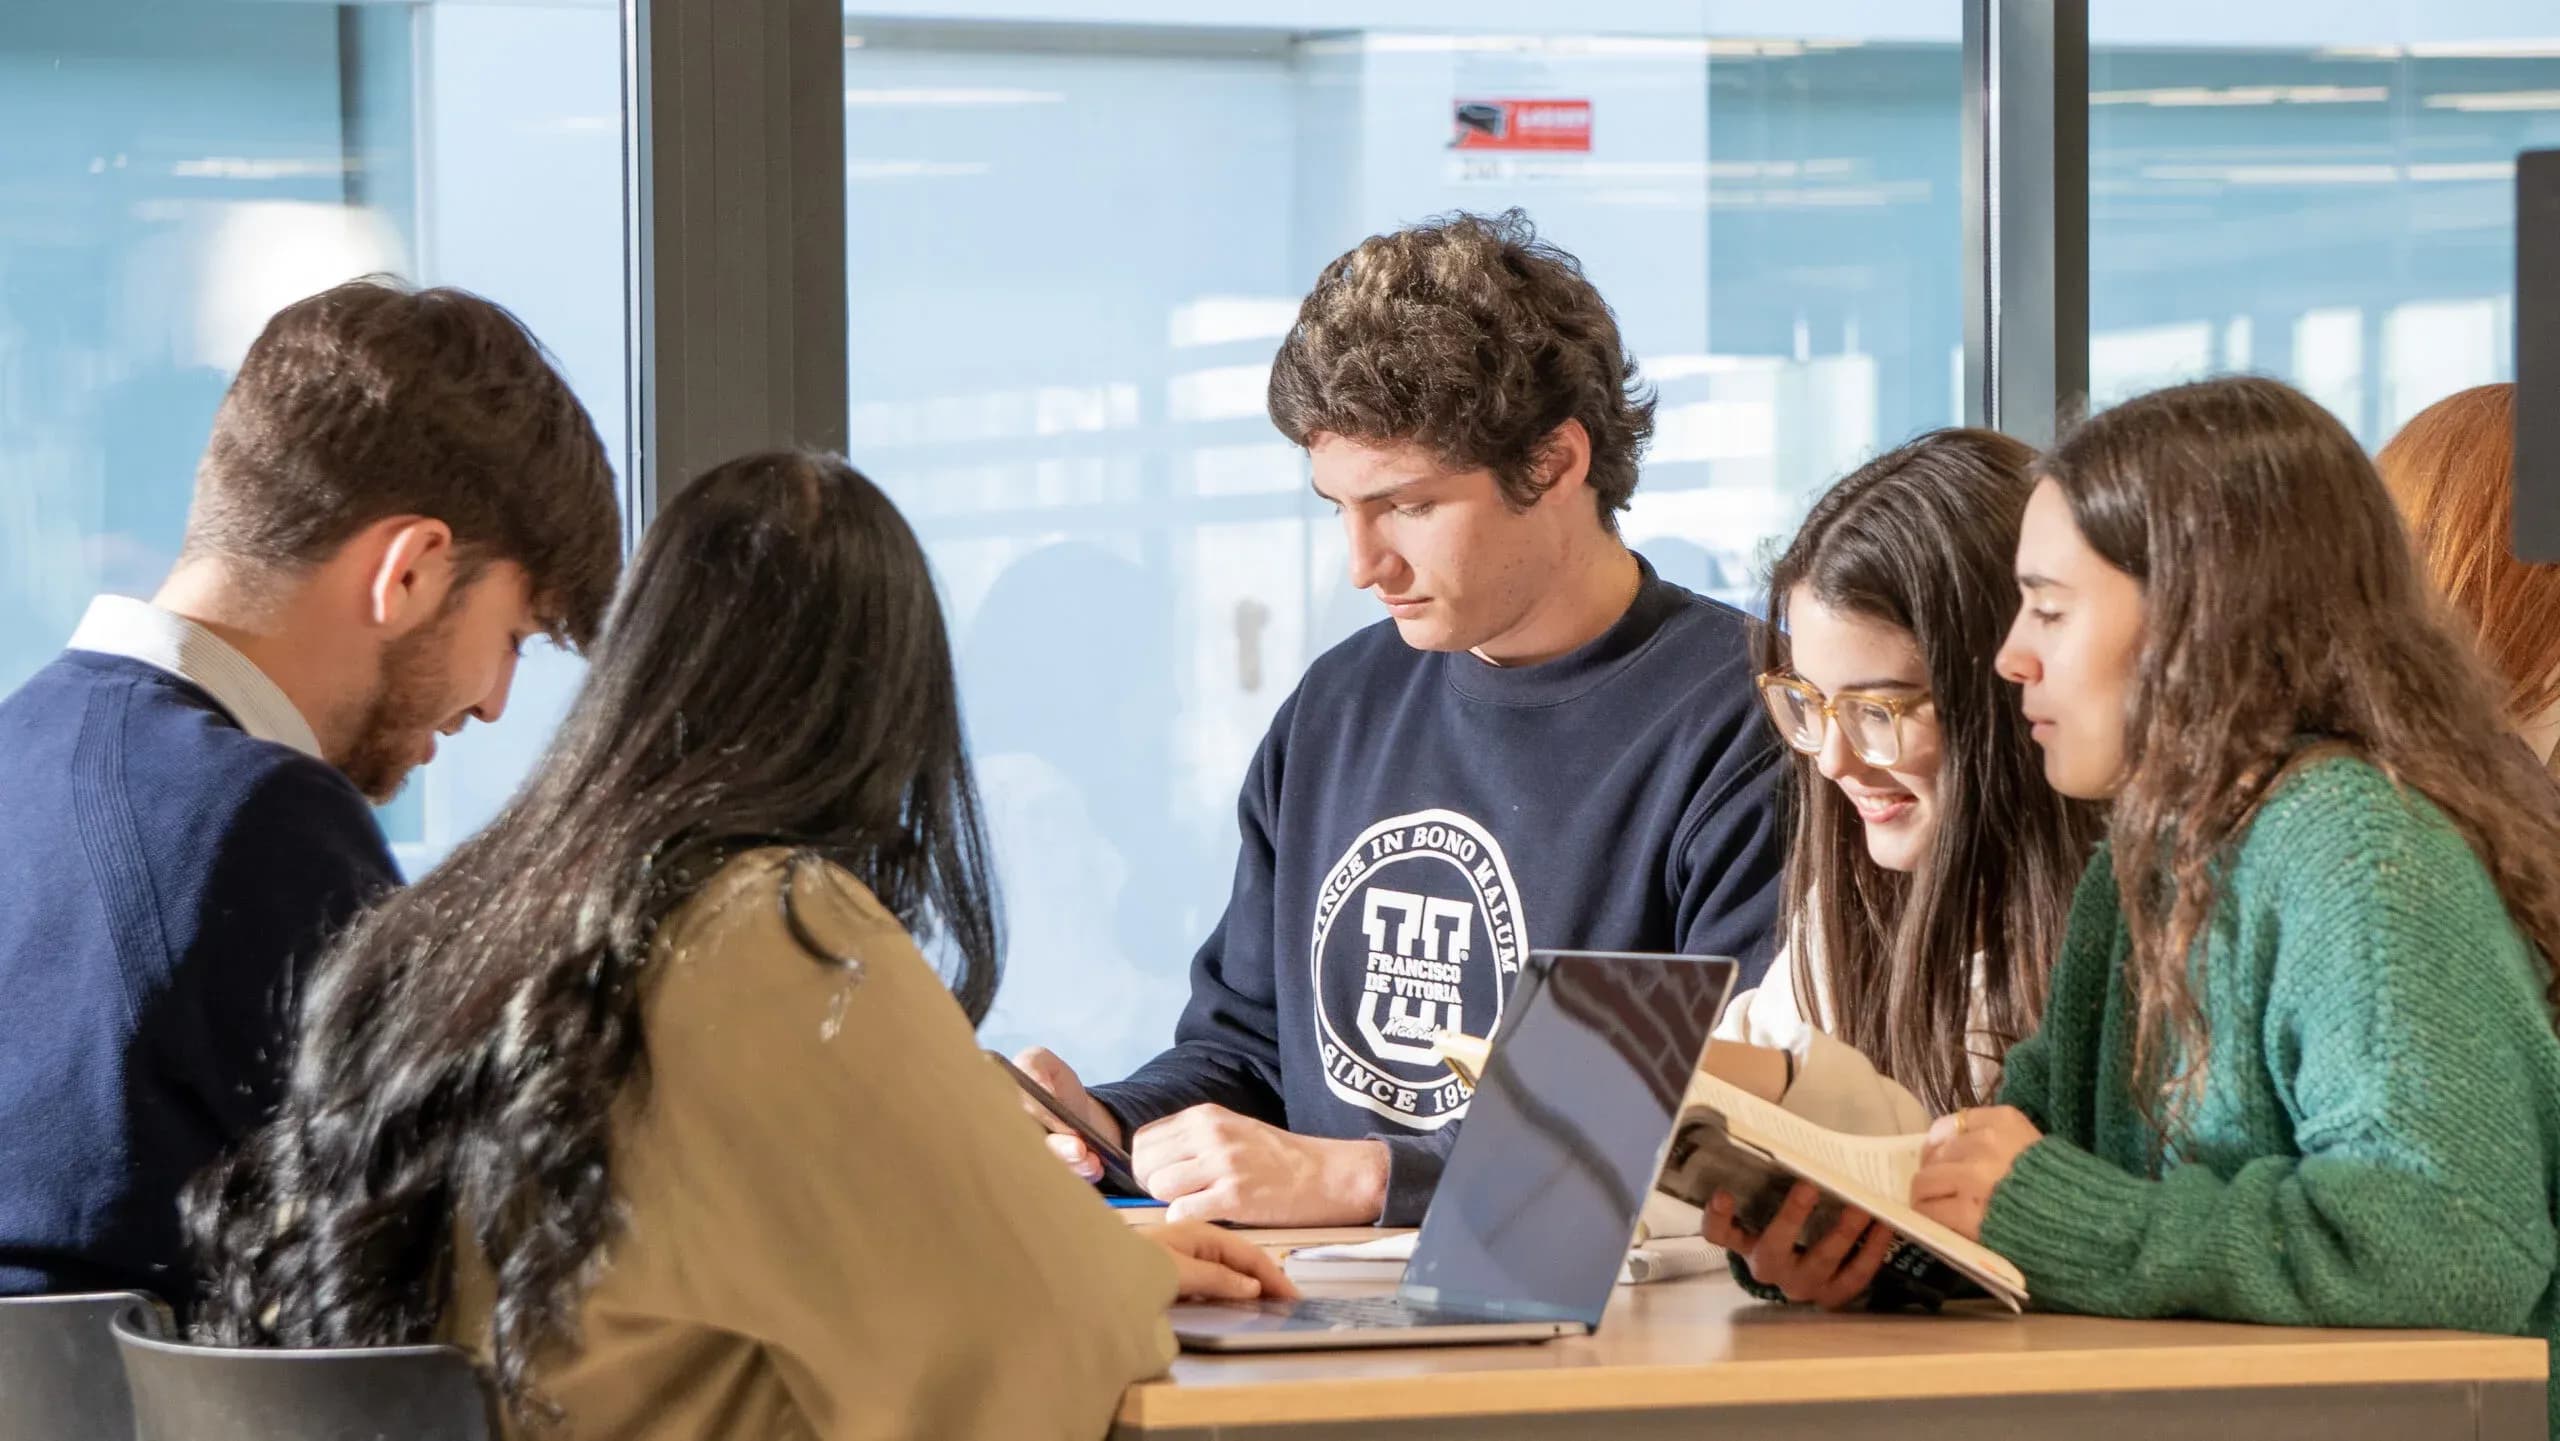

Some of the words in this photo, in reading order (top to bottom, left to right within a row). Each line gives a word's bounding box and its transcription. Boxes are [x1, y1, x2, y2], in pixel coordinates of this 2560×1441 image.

[1370, 830, 1405, 859] IN
[1412, 826, 1477, 862] BONO
[1473, 858, 1518, 974] MALUM
[1367, 952, 1461, 984] FRANCISCO
[1365, 972, 1392, 993] DE
[1394, 976, 1462, 1004] VITORIA
[1380, 1016, 1441, 1042] Madrid
[1323, 1043, 1418, 1113] SINCE
[1433, 1079, 1475, 1113] 199
